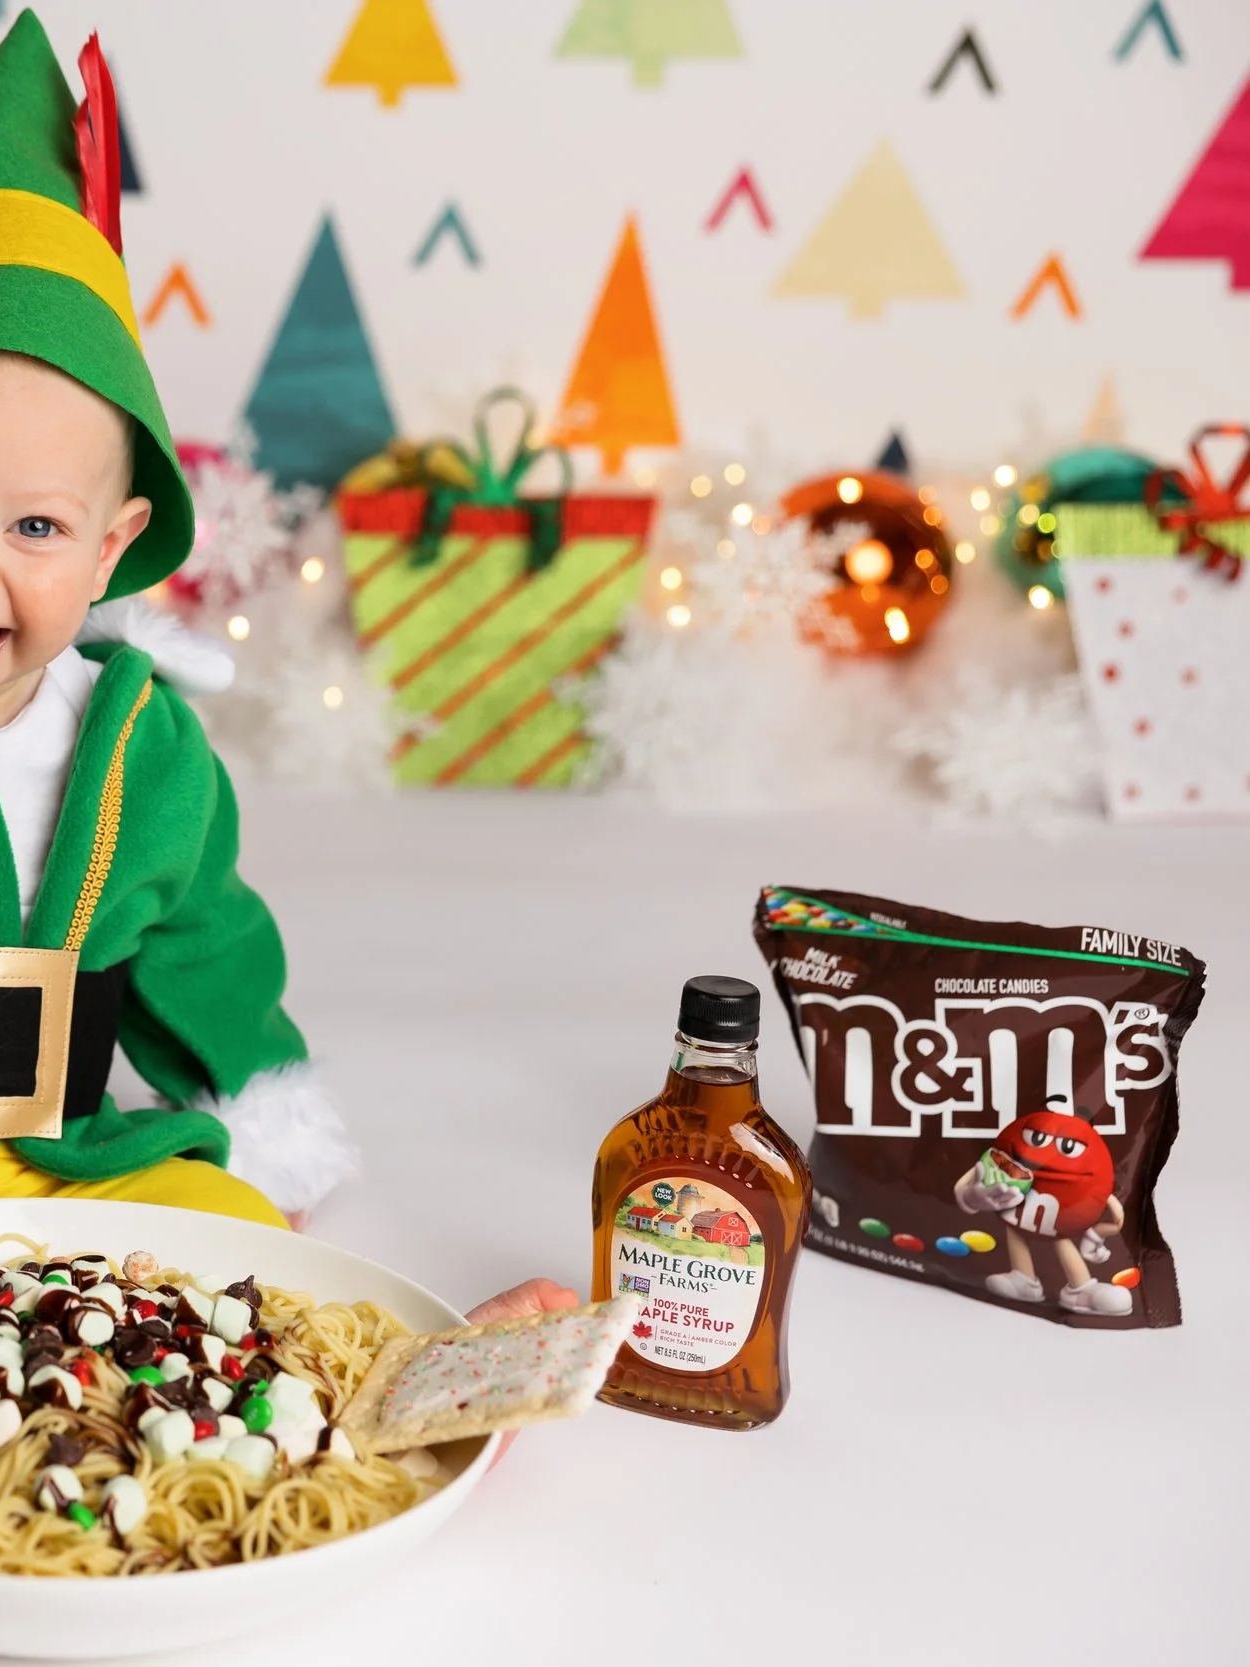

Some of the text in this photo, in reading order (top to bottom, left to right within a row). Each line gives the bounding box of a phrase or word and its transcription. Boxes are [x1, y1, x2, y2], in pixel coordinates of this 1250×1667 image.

[1081, 928, 1182, 967] FAMILY SIZE
[804, 947, 841, 969] MILK
[779, 957, 858, 990] CHOCOLATE
[935, 978, 1049, 994] CHOCOLATE CANDIES
[655, 1192, 672, 1200] LOOK
[619, 1243, 756, 1285] MAPLE GROVE
[659, 1273, 709, 1293] FARMS
[653, 1298, 709, 1317] 100% PURE
[638, 1306, 734, 1334] APLE SYRUP
[660, 1329, 681, 1338] GRADE
[691, 1336, 713, 1344] AMBER
[654, 1346, 664, 1355] NET
[664, 1347, 672, 1358] 8.5
[672, 1348, 679, 1359] FL
[679, 1350, 687, 1360] OZ
